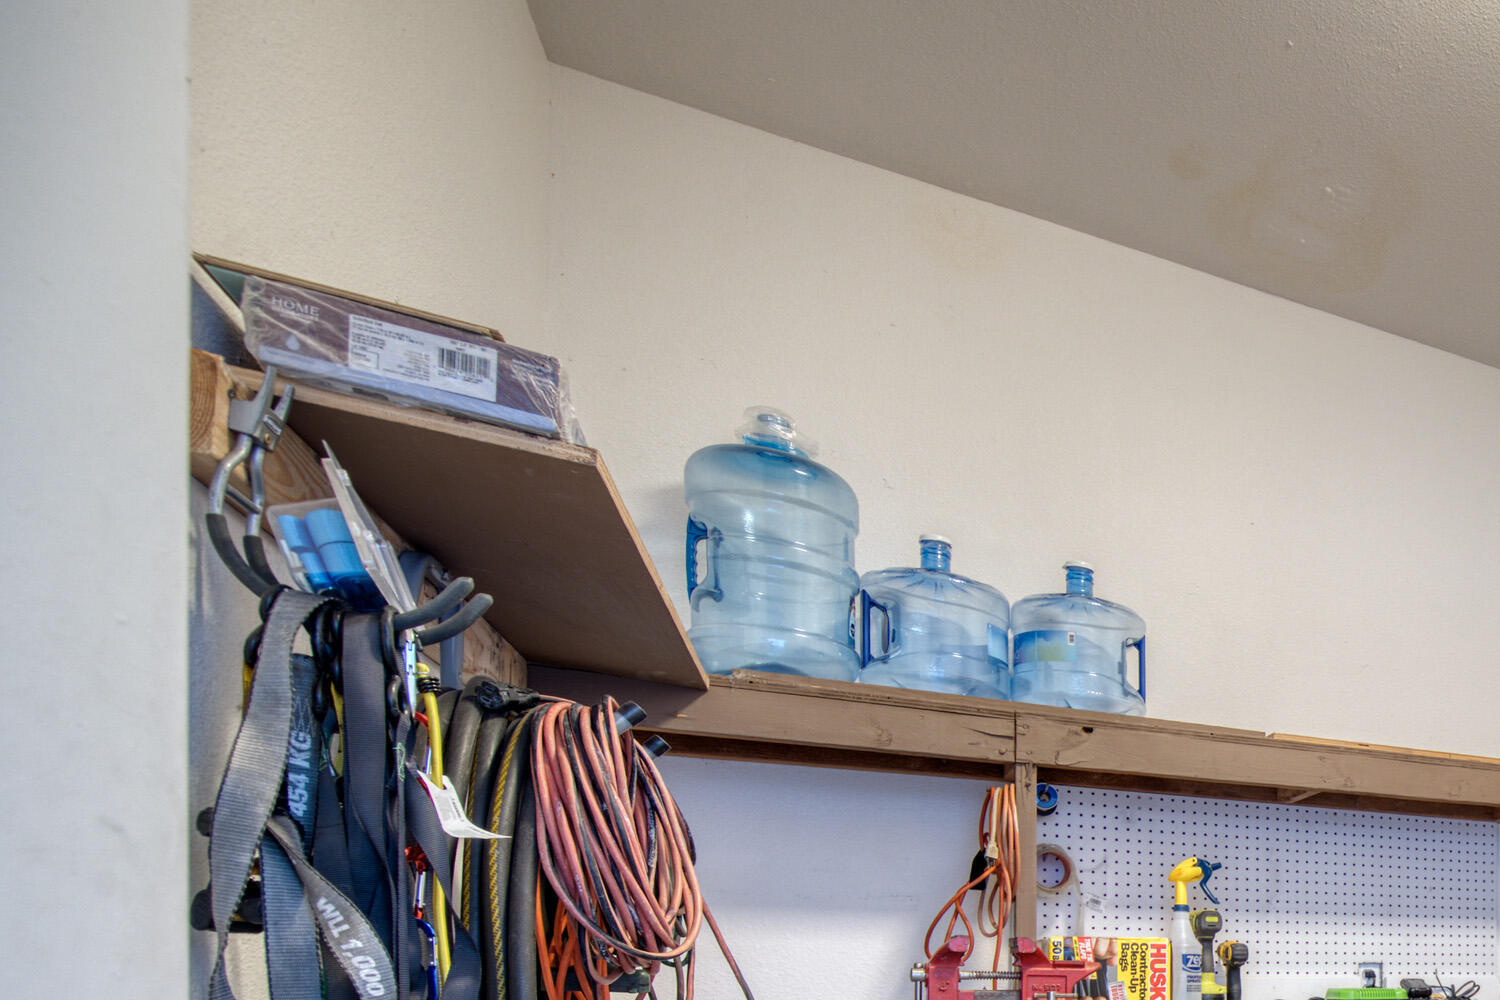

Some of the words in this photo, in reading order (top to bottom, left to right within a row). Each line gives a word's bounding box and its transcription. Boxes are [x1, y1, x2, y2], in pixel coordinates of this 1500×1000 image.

[271, 296, 320, 317] HOME
[288, 730, 312, 768] KG
[287, 773, 311, 817] 454
[317, 897, 350, 939] WLL
[340, 938, 385, 997] 1,000
[1119, 943, 1130, 972] Bags
[1129, 943, 1140, 993] Clean-Up
